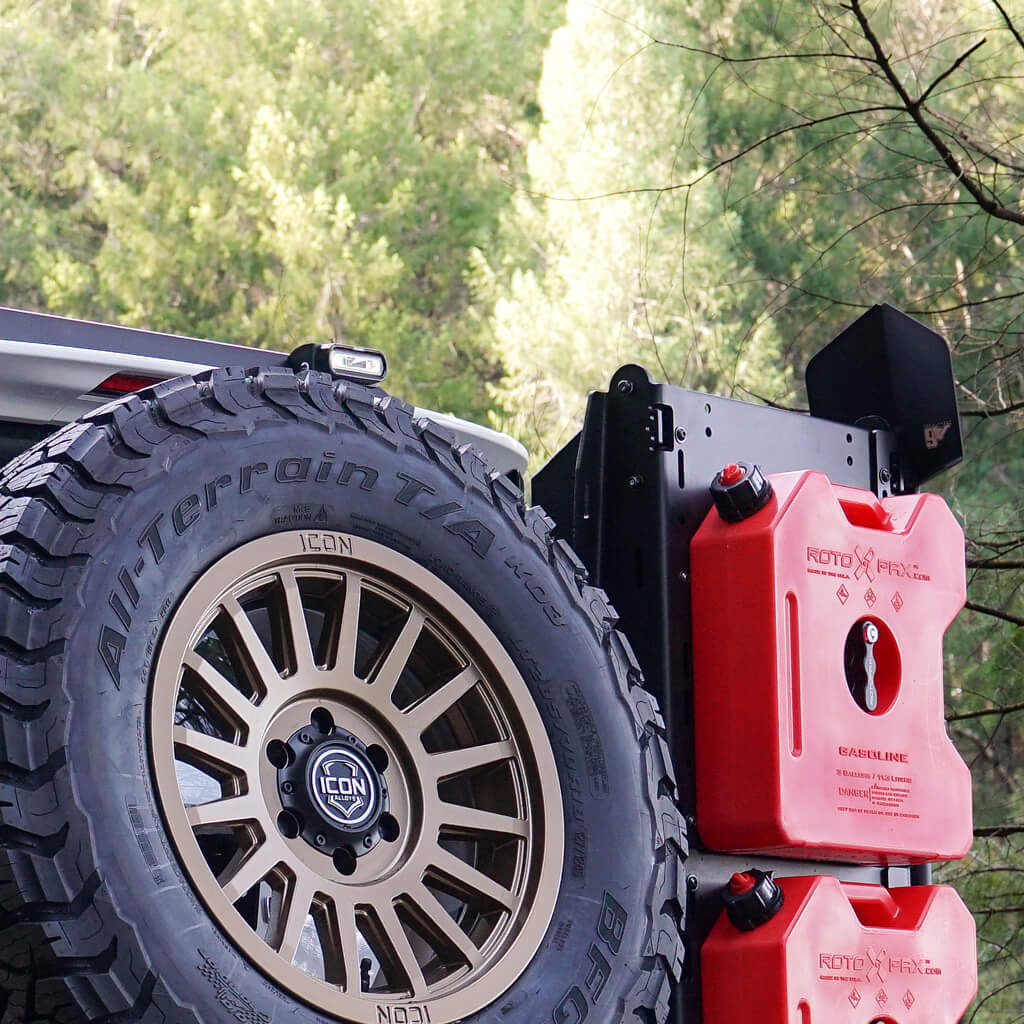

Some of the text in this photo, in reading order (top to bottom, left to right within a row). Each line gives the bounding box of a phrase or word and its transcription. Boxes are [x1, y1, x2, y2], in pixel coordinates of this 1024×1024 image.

[299, 534, 353, 555] ICON
[807, 546, 853, 569] ROTO
[98, 450, 380, 691] All-Terrain
[395, 471, 497, 559] T/A
[838, 746, 909, 764] GASOLINE
[320, 776, 367, 795] ICON
[838, 786, 869, 799] DANGER
[819, 952, 864, 971] ROTO
[376, 1004, 431, 1024] ICON
